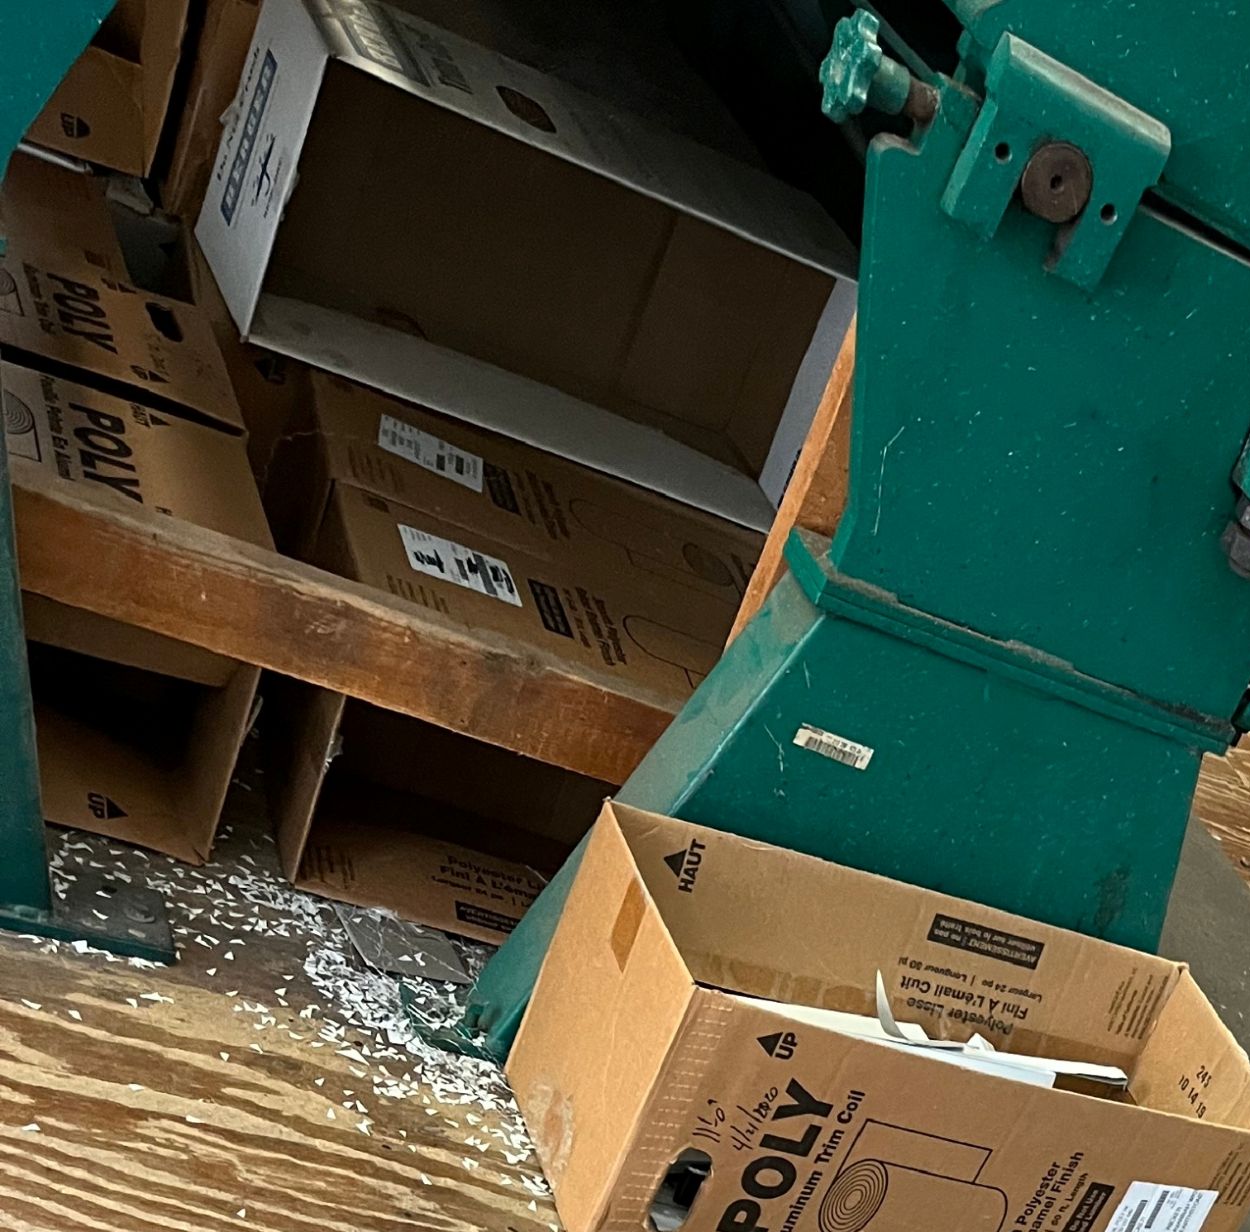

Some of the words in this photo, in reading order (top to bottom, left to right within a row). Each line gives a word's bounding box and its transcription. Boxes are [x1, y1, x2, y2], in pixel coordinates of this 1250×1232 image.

[47, 272, 118, 355] POLY
[68, 402, 143, 502] POLY
[87, 792, 107, 820] UP
[678, 838, 706, 893] HAUT
[901, 976, 930, 993] Cuit
[934, 985, 985, 1008] L'émail
[995, 984, 1006, 992] 24
[907, 998, 944, 1019] Lisse
[948, 1008, 1013, 1035] Polyester
[1001, 1003, 1028, 1019] Fini
[775, 1032, 798, 1060] UP
[1178, 1075, 1190, 1092] 10
[814, 1130, 846, 1164] Trim
[837, 1090, 866, 1125] Coil
[1050, 1152, 1084, 1193] Finish
[1015, 1162, 1064, 1225] Polyester
[1066, 1173, 1088, 1201] Length
